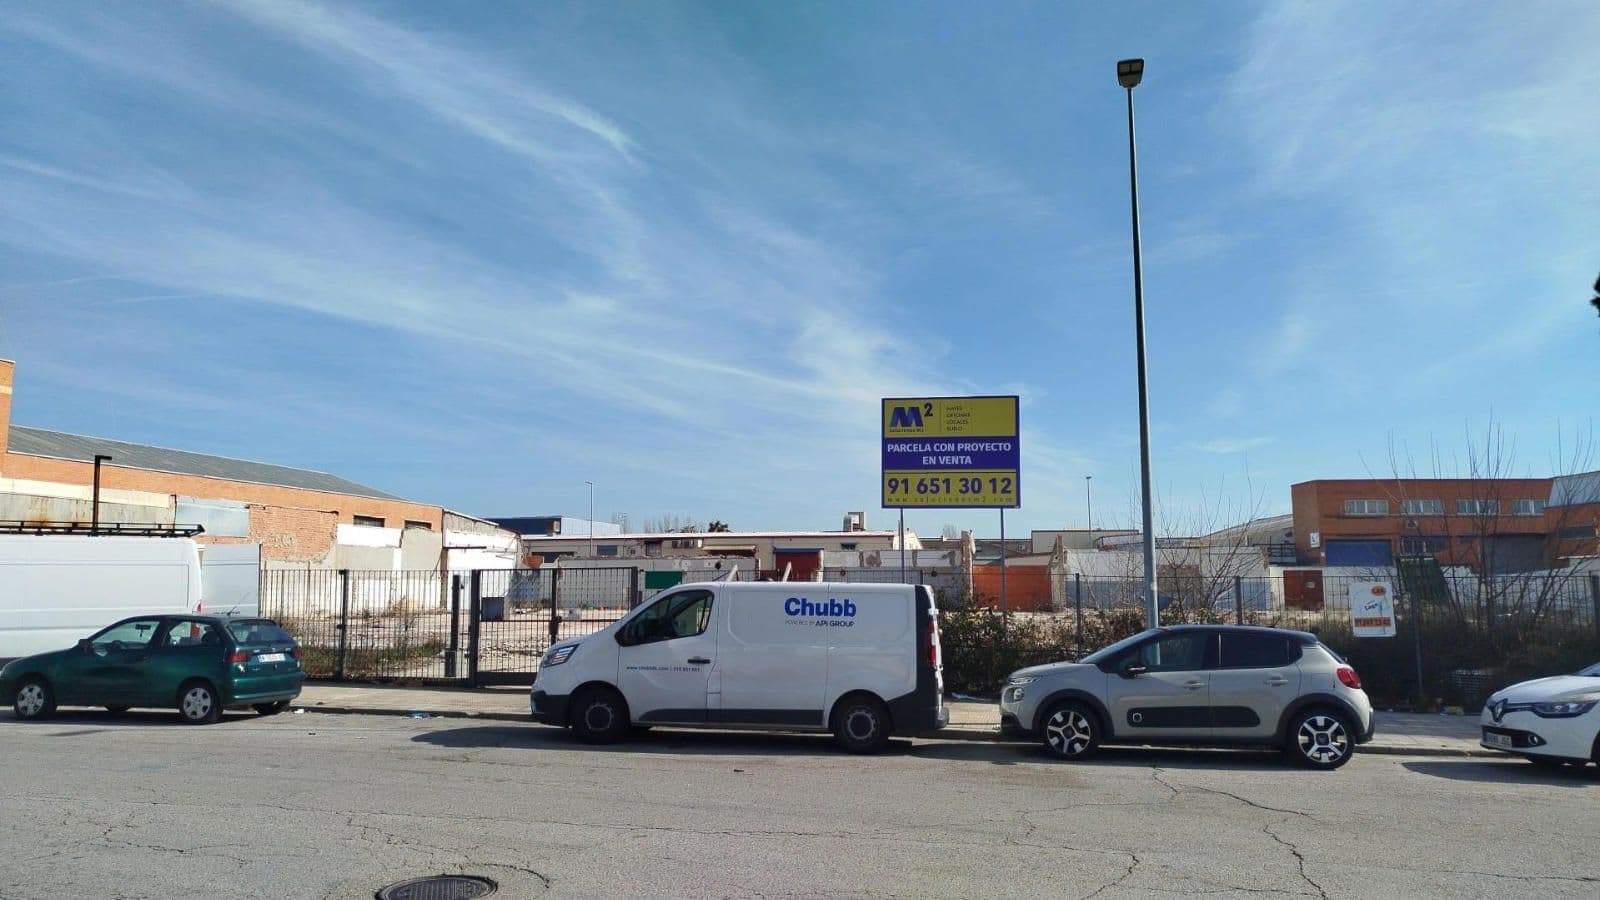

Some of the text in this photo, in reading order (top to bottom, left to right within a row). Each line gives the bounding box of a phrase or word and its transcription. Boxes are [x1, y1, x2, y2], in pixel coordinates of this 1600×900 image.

[887, 442, 1011, 453] PARCELA CON PROYECTO
[922, 455, 972, 465] EN VENTA
[888, 477, 1012, 494] 91 651 30 12
[784, 597, 857, 617] Chubb
